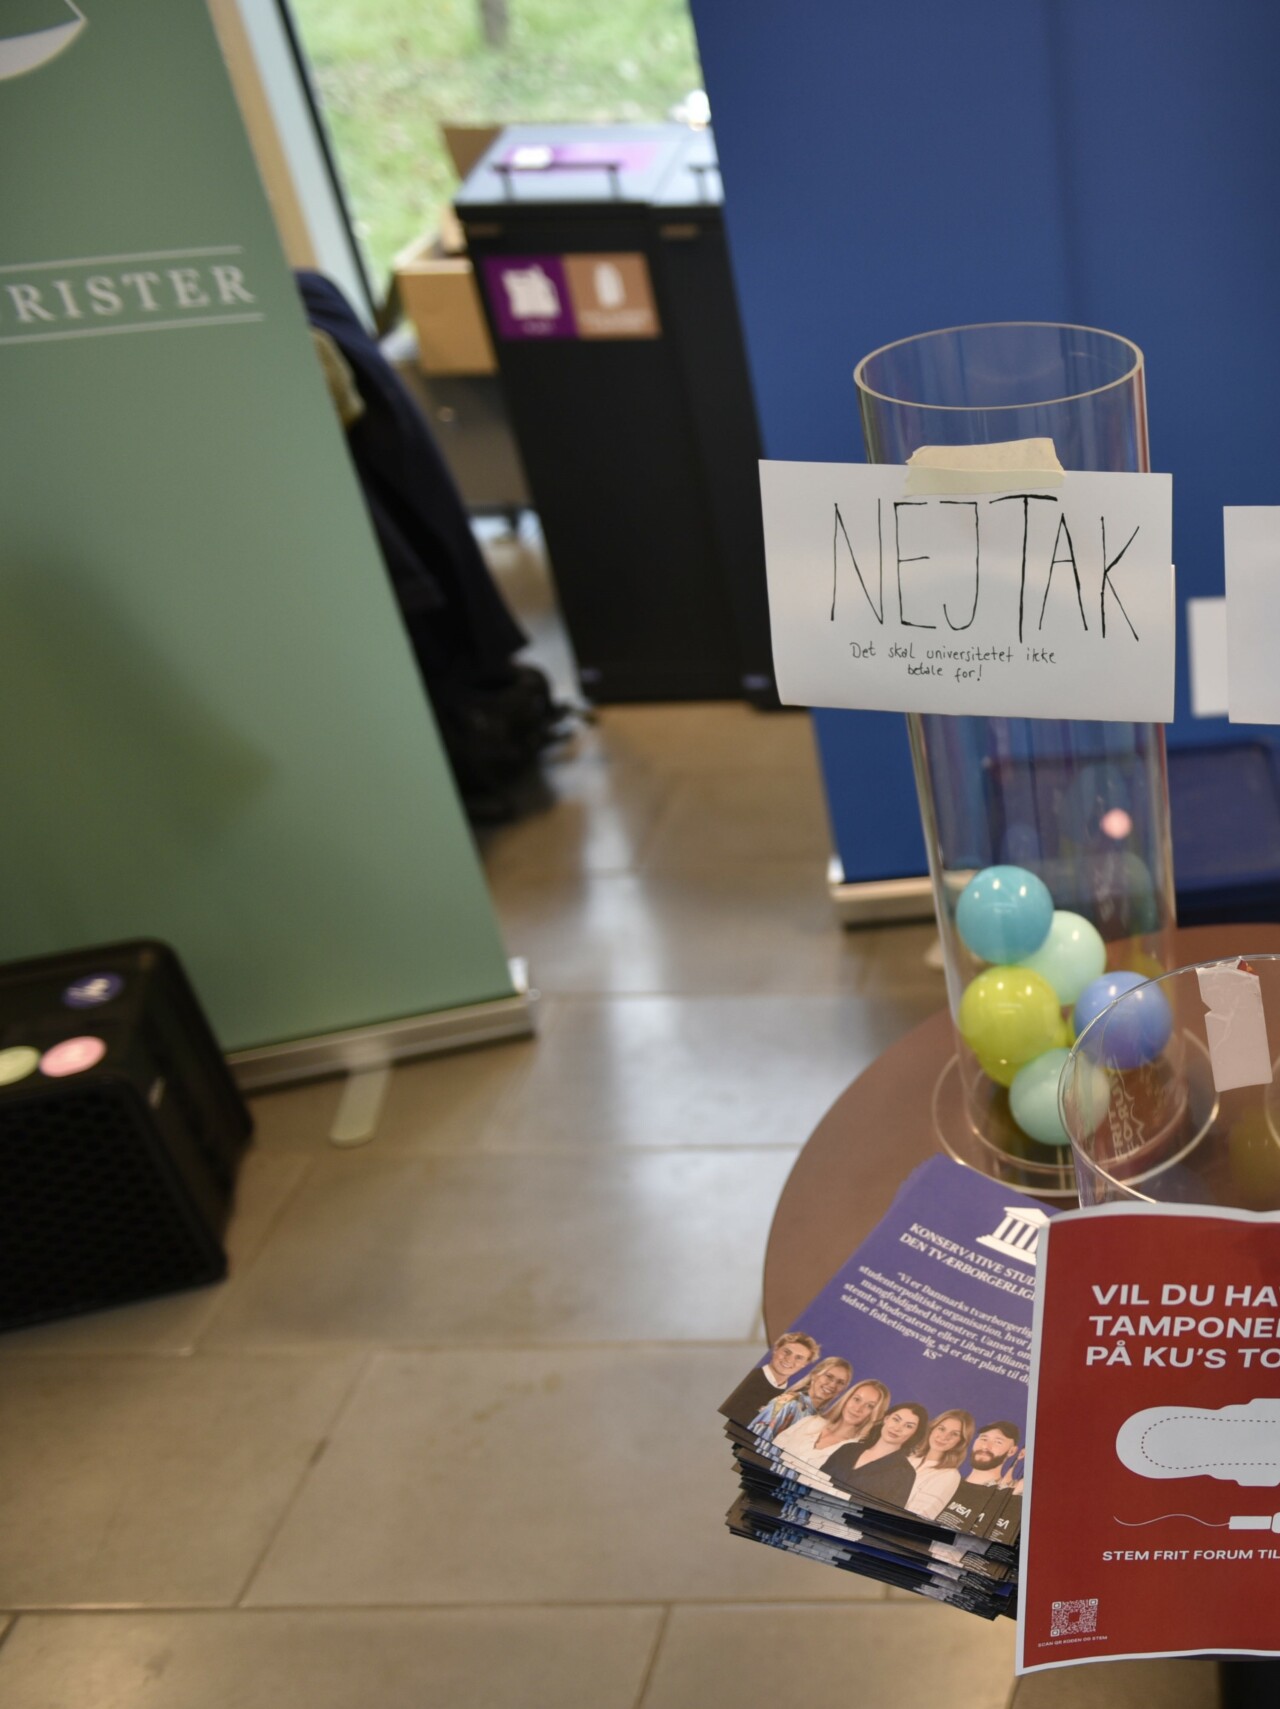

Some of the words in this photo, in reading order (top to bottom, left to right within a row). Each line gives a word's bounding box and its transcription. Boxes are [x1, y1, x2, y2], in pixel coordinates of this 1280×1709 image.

[850, 641, 876, 659] Det
[888, 642, 915, 659] skal
[926, 643, 1014, 664] universitetet
[1026, 646, 1058, 664] ikke
[907, 663, 944, 677] betale
[954, 664, 983, 682] for!
[899, 1232, 928, 1252] DEN
[908, 1222, 1005, 1274] KONSERVATIVE
[858, 1265, 943, 1312] studenterpolitiske
[1003, 1331, 1029, 1347] hvor
[860, 1279, 932, 1320] mangfoldighed
[921, 1284, 970, 1313] Danmarks
[1091, 1284, 1149, 1306] VIL
[1160, 1284, 1215, 1306] DU
[842, 1283, 878, 1304] stemte
[876, 1299, 938, 1335] Moderaterne
[936, 1330, 961, 1345] eller
[960, 1338, 996, 1359] Liberal
[841, 1294, 871, 1313] sidste
[961, 1352, 981, 1365] der
[978, 1360, 1007, 1376] plads
[1006, 1369, 1020, 1380] til
[1086, 1339, 1132, 1366] PÅ
[1102, 1550, 1149, 1561] STEM
[1153, 1550, 1190, 1560] FRIT
[1193, 1549, 1254, 1560] FORUM
